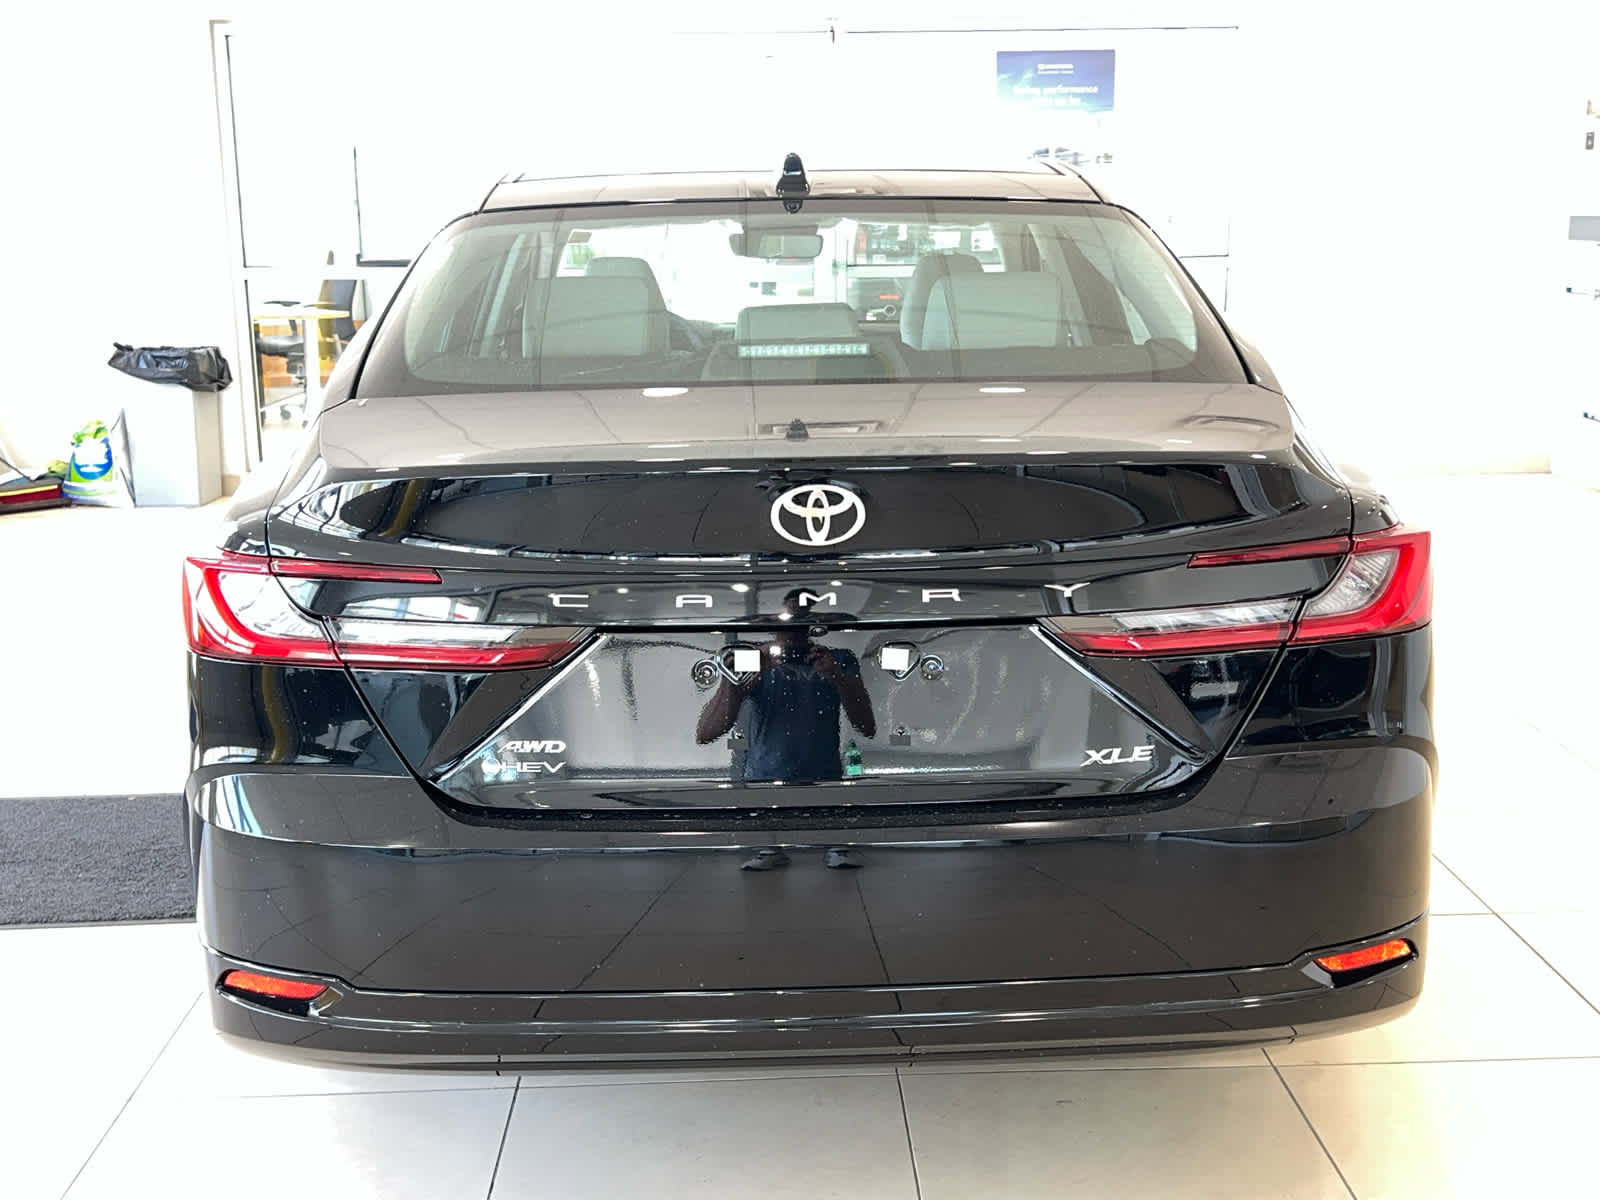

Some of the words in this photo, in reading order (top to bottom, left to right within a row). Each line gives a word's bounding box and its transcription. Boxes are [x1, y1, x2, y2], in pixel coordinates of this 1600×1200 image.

[549, 582, 1091, 609] CAMRY
[497, 740, 567, 754] AWD
[1080, 744, 1156, 767] XLE
[500, 761, 567, 774] HEV
